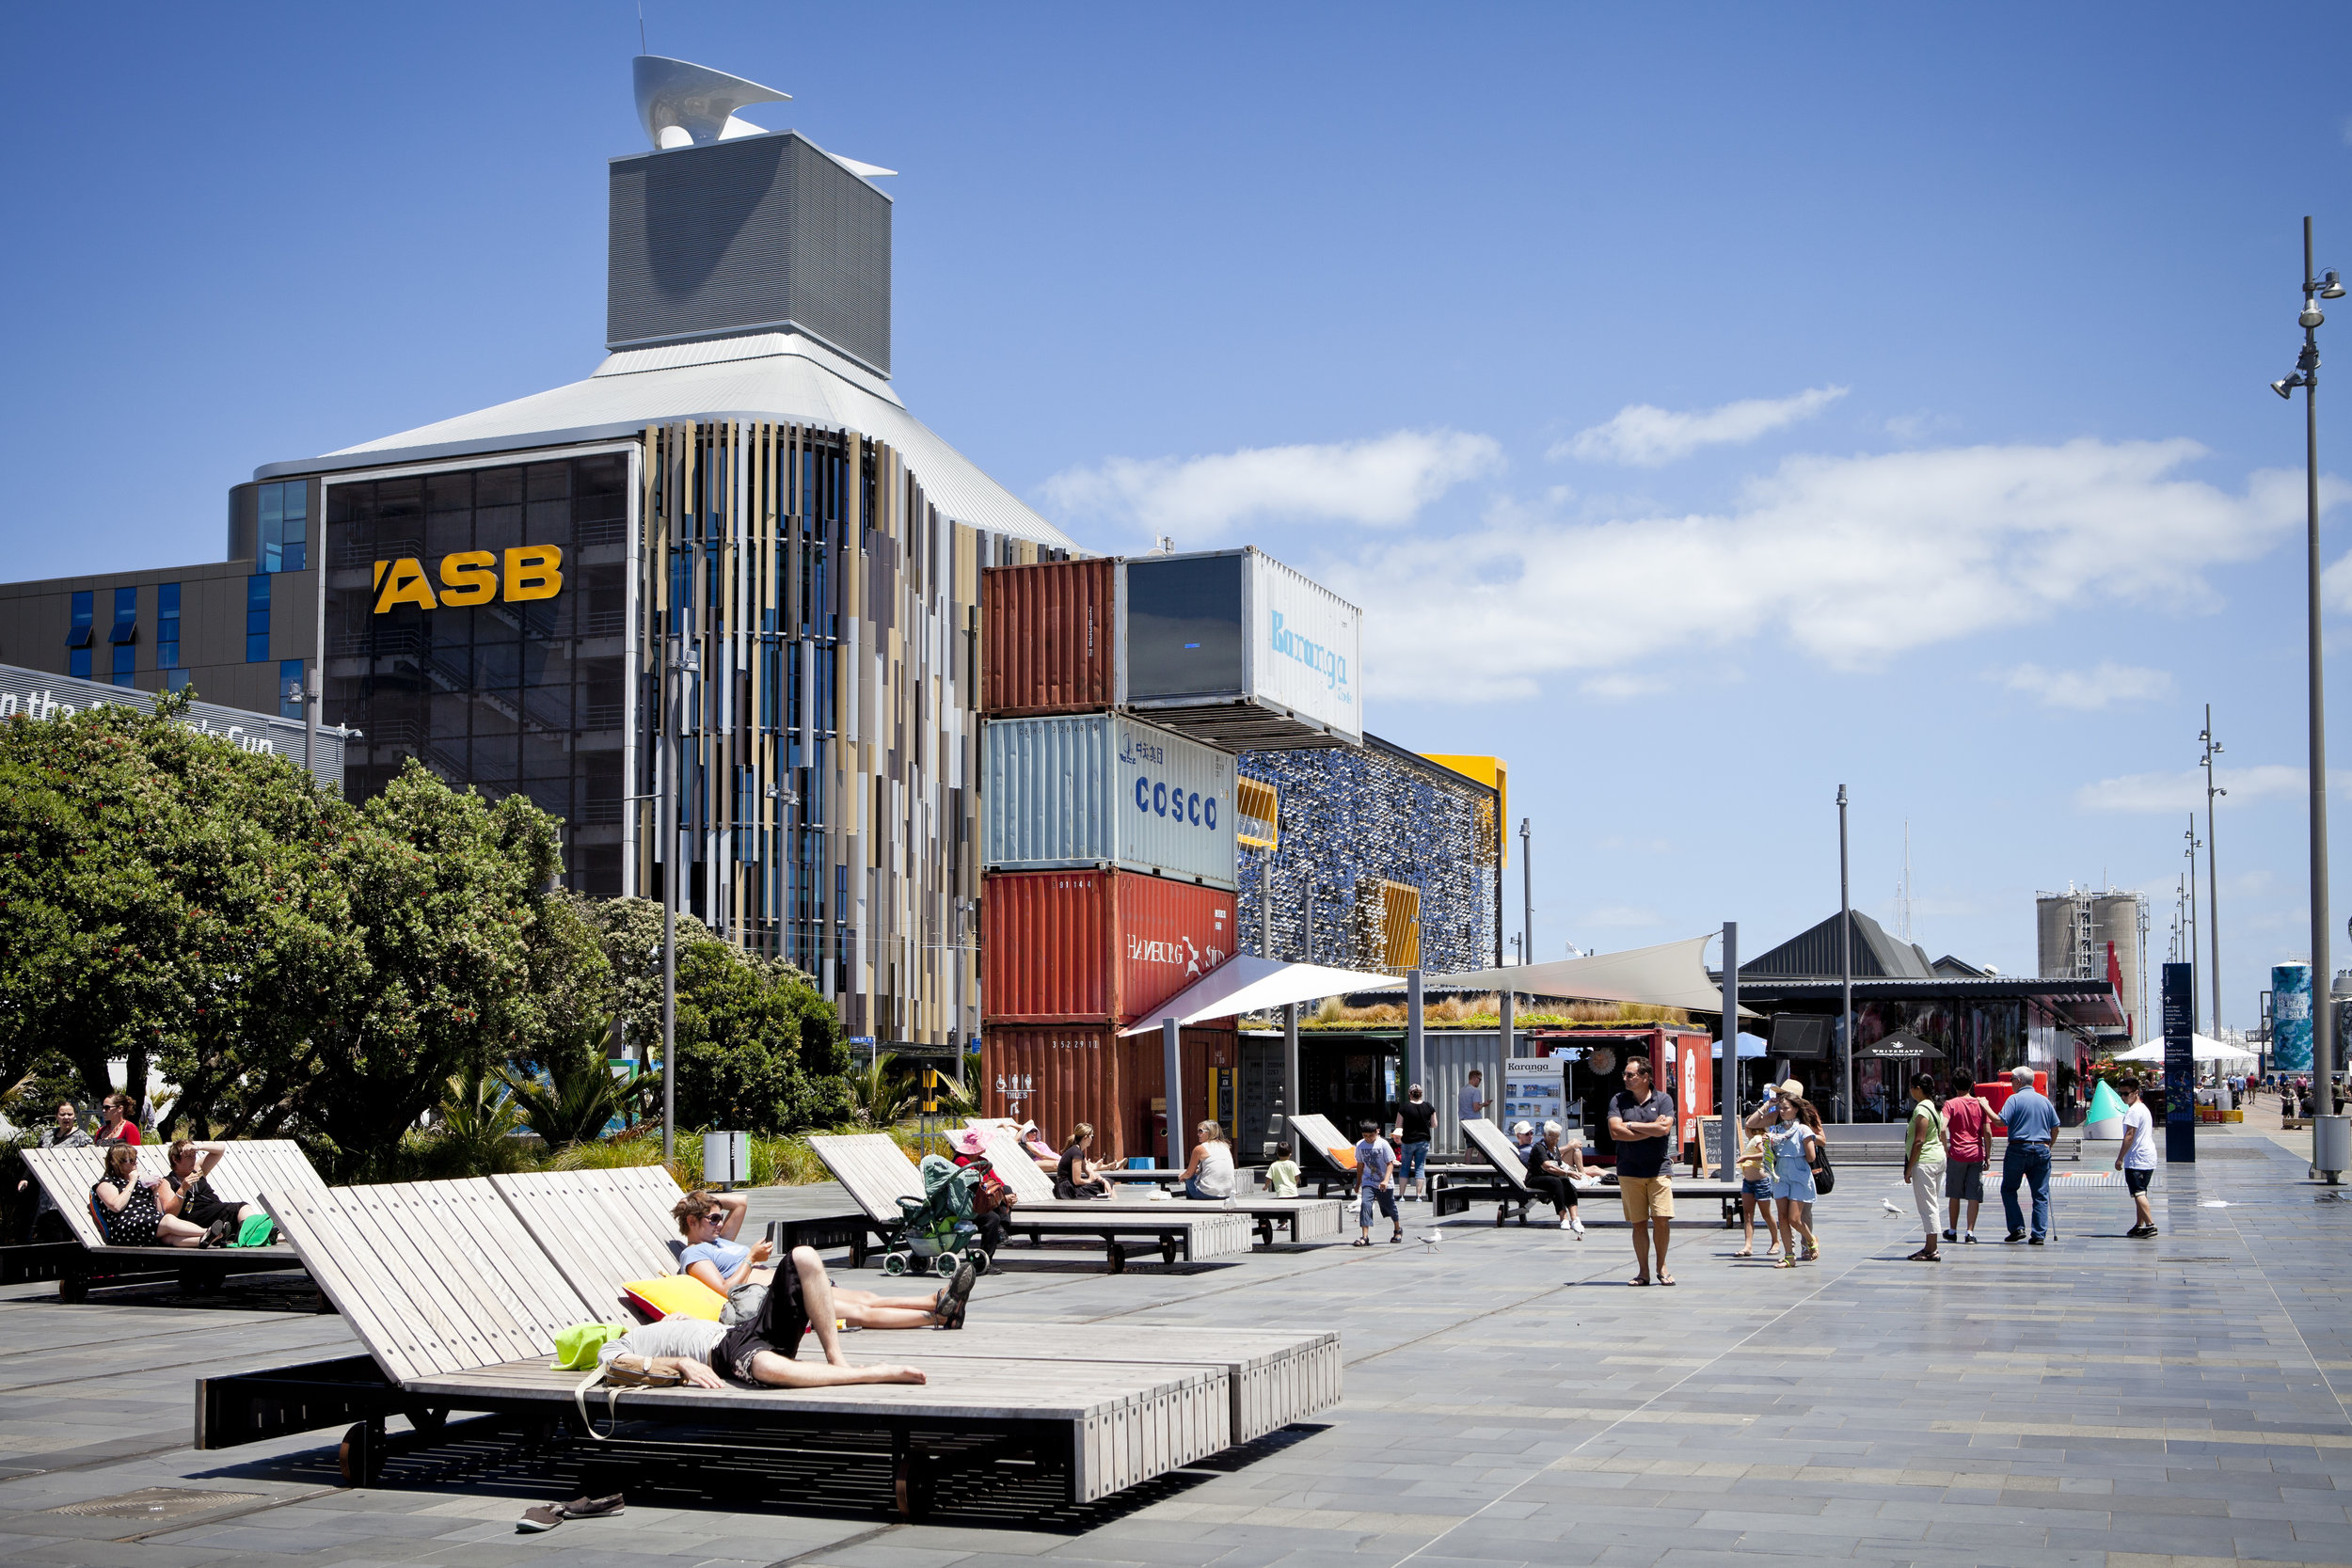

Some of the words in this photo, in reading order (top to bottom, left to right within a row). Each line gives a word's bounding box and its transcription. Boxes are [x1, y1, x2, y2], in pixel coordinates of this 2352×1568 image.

[373, 544, 564, 613] ASB
[1135, 776, 1217, 831] COSCO
[1507, 1062, 1549, 1072] Karanga
